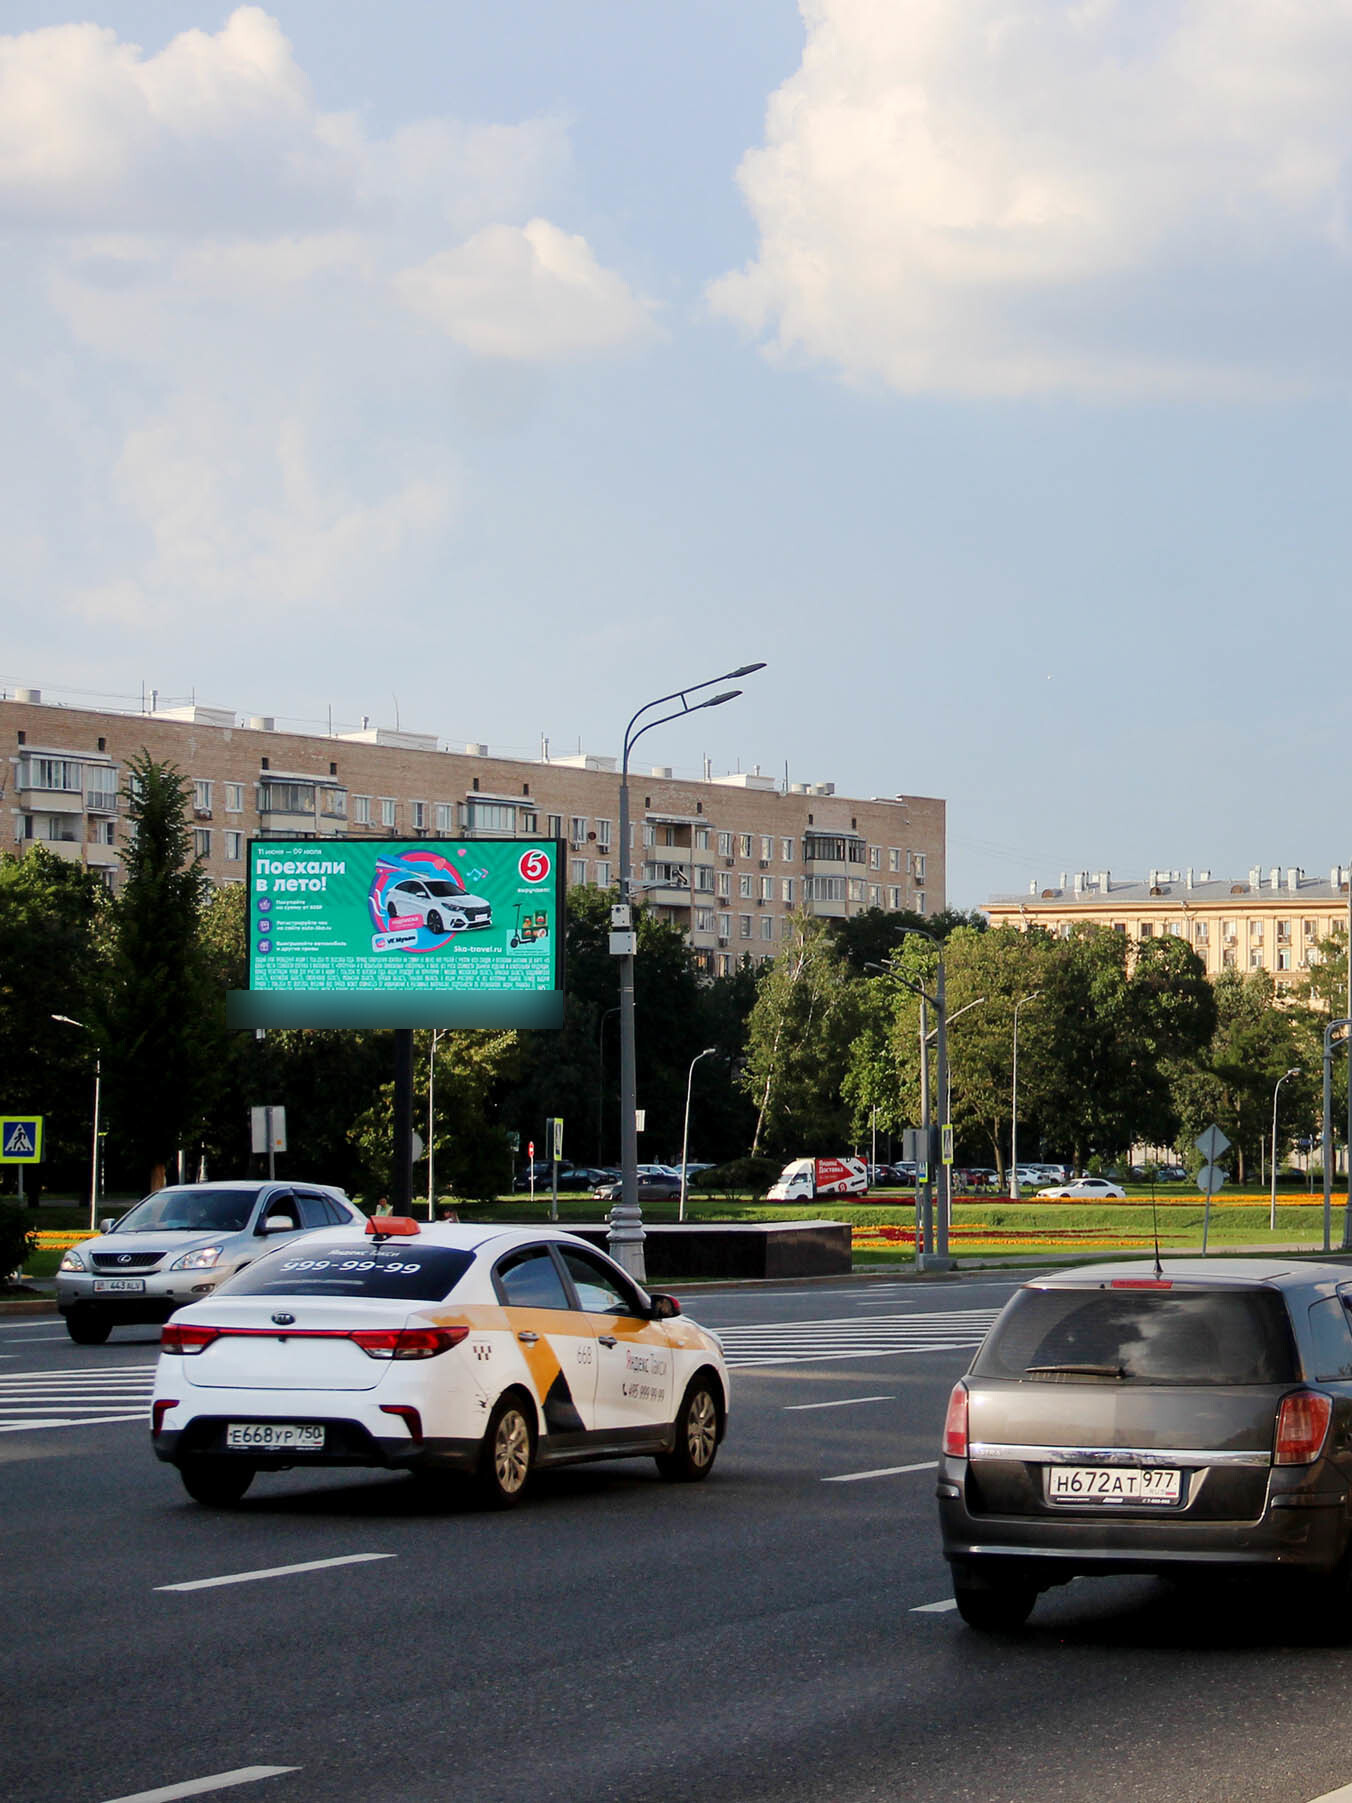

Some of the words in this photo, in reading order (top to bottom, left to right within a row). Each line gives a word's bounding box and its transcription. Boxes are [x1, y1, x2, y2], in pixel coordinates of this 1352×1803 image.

[256, 858, 346, 875] Поехали
[256, 878, 268, 892] в
[273, 876, 327, 892] лето!
[280, 1260, 422, 1274] 999-99-99
[232, 1427, 293, 1443] Е668УР
[296, 1426, 321, 1439] 750
[1057, 1471, 1138, 1493] Н672АТ
[1143, 1471, 1174, 1488] 977
